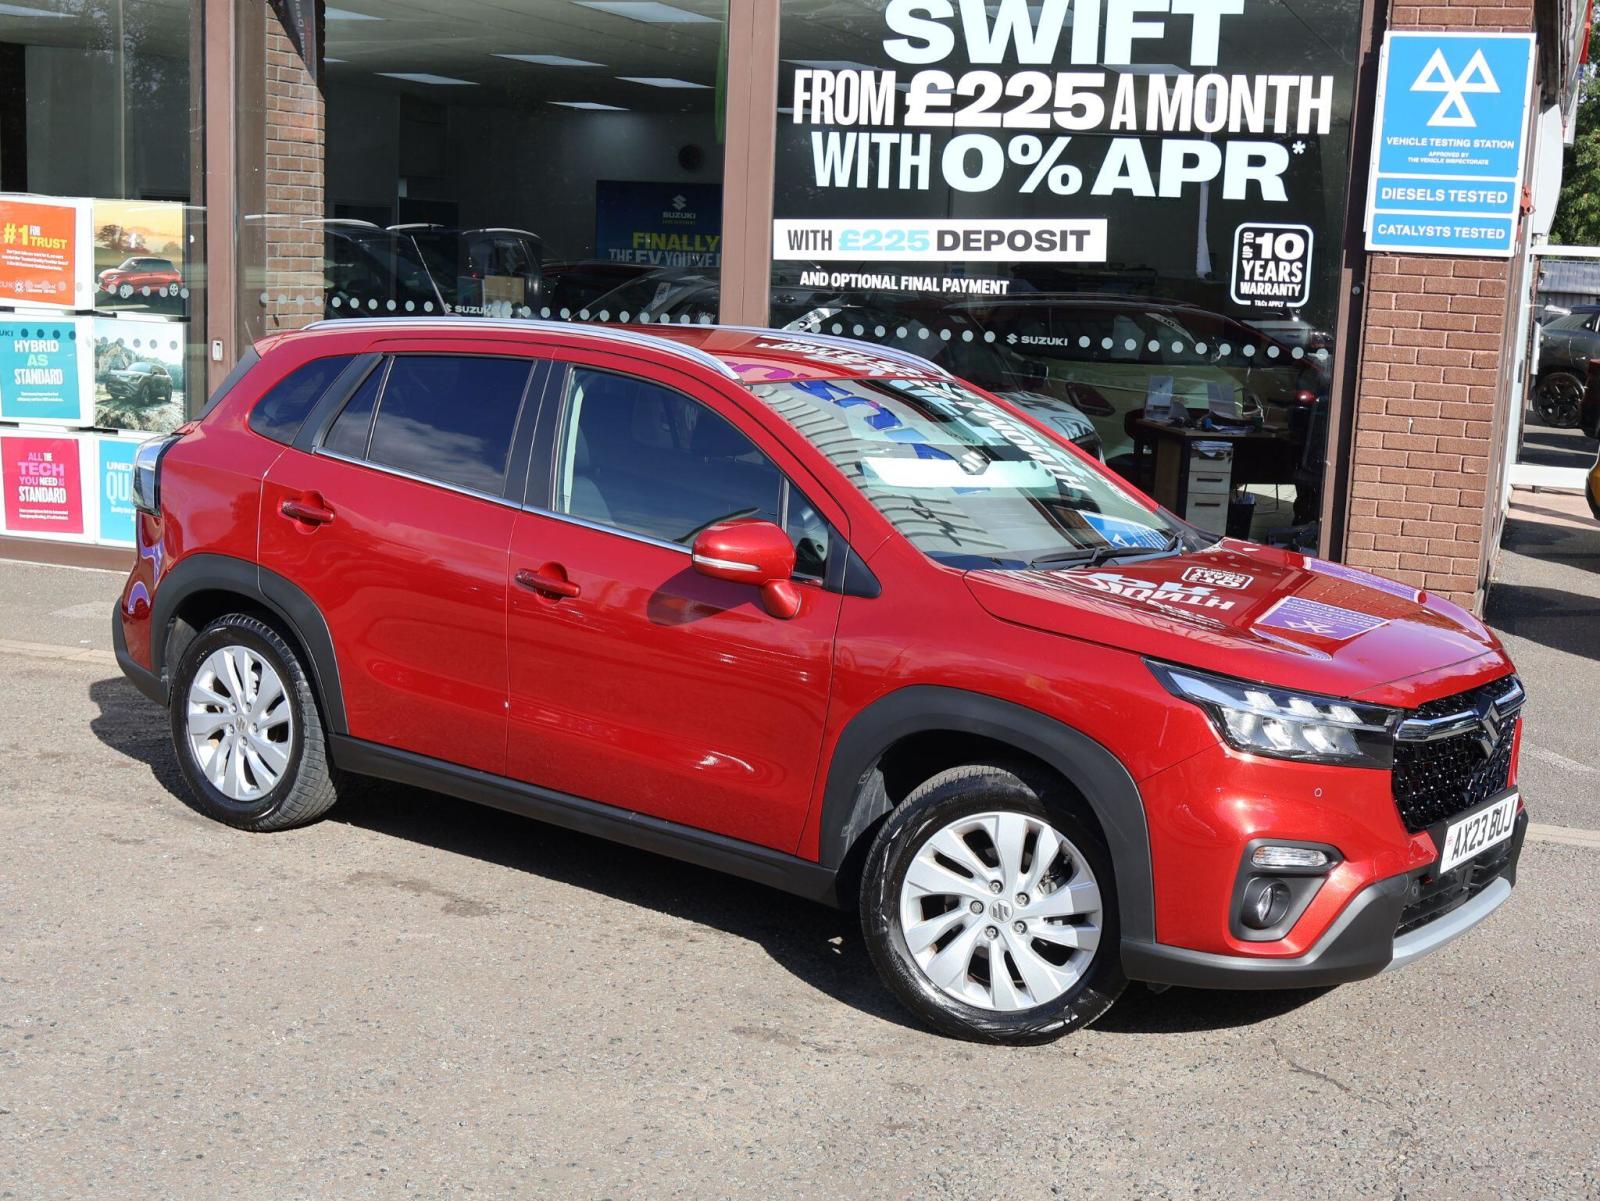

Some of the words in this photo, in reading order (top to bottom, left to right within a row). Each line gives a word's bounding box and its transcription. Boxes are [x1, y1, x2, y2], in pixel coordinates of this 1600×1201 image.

[882, 0, 1245, 66] SWIFT
[793, 69, 896, 126] FROM
[904, 70, 1105, 130] £225
[1110, 73, 1140, 130] A
[1146, 74, 1334, 135] MONTH
[1386, 136, 1427, 147] VEHICLE
[1429, 138, 1471, 148] TESTING
[1473, 139, 1515, 149] STATION
[811, 131, 932, 190] WITH
[941, 133, 1083, 196] 0%
[1381, 187, 1445, 202] DIESELS
[1449, 189, 1508, 204] TESTED
[662, 211, 696, 219] SUZUKI
[3, 222, 29, 246] #1
[1377, 223, 1451, 237] CATALYSTS
[1454, 225, 1506, 239] TESTED
[30, 236, 68, 249] TRUST
[632, 231, 720, 252] FINALLY
[787, 229, 833, 252] WITH
[838, 228, 930, 253] £225
[936, 229, 1091, 252] DEPOSIT
[1255, 232, 1305, 260] 10
[1242, 245, 1253, 258] UP
[1242, 260, 1303, 283] YEARS
[800, 271, 829, 287] AND
[830, 272, 898, 291] OPTIONAL
[900, 275, 941, 293] FINAL
[942, 277, 1009, 296] PAYMENT
[1240, 282, 1301, 296] WARRANTY
[14, 339, 60, 353] HYBRID
[1020, 335, 1069, 347] SUZUKI
[26, 353, 49, 367] AS
[14, 368, 64, 385] STANDARD
[27, 452, 43, 461] ALL
[17, 461, 65, 476] TECH
[18, 476, 39, 486] YOU
[39, 477, 58, 487] NEED
[18, 486, 67, 504] STANDARD
[1451, 813, 1489, 861] AX23
[1487, 799, 1516, 842] BUJ
